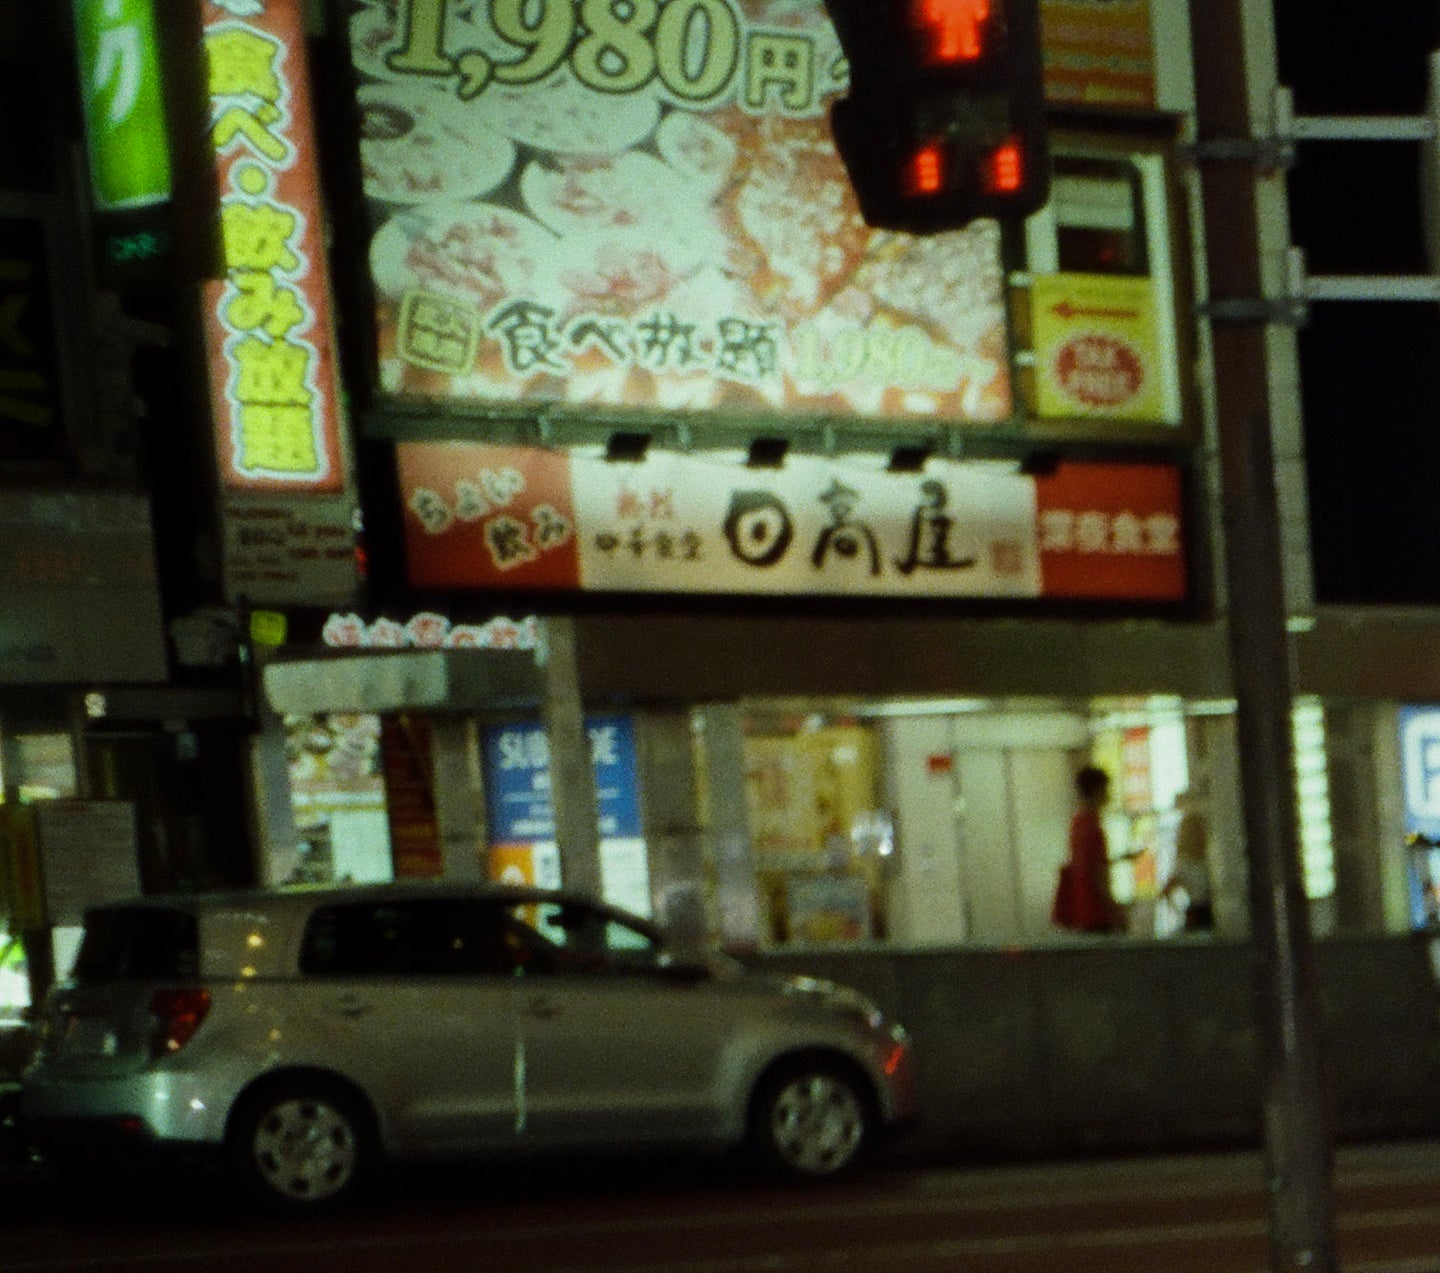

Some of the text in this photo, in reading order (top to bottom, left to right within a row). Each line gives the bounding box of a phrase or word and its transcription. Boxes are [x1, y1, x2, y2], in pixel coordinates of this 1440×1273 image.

[384, 0, 851, 112] 1,980円
[486, 298, 781, 377] 食べ放題
[724, 480, 976, 576] 日高屋
